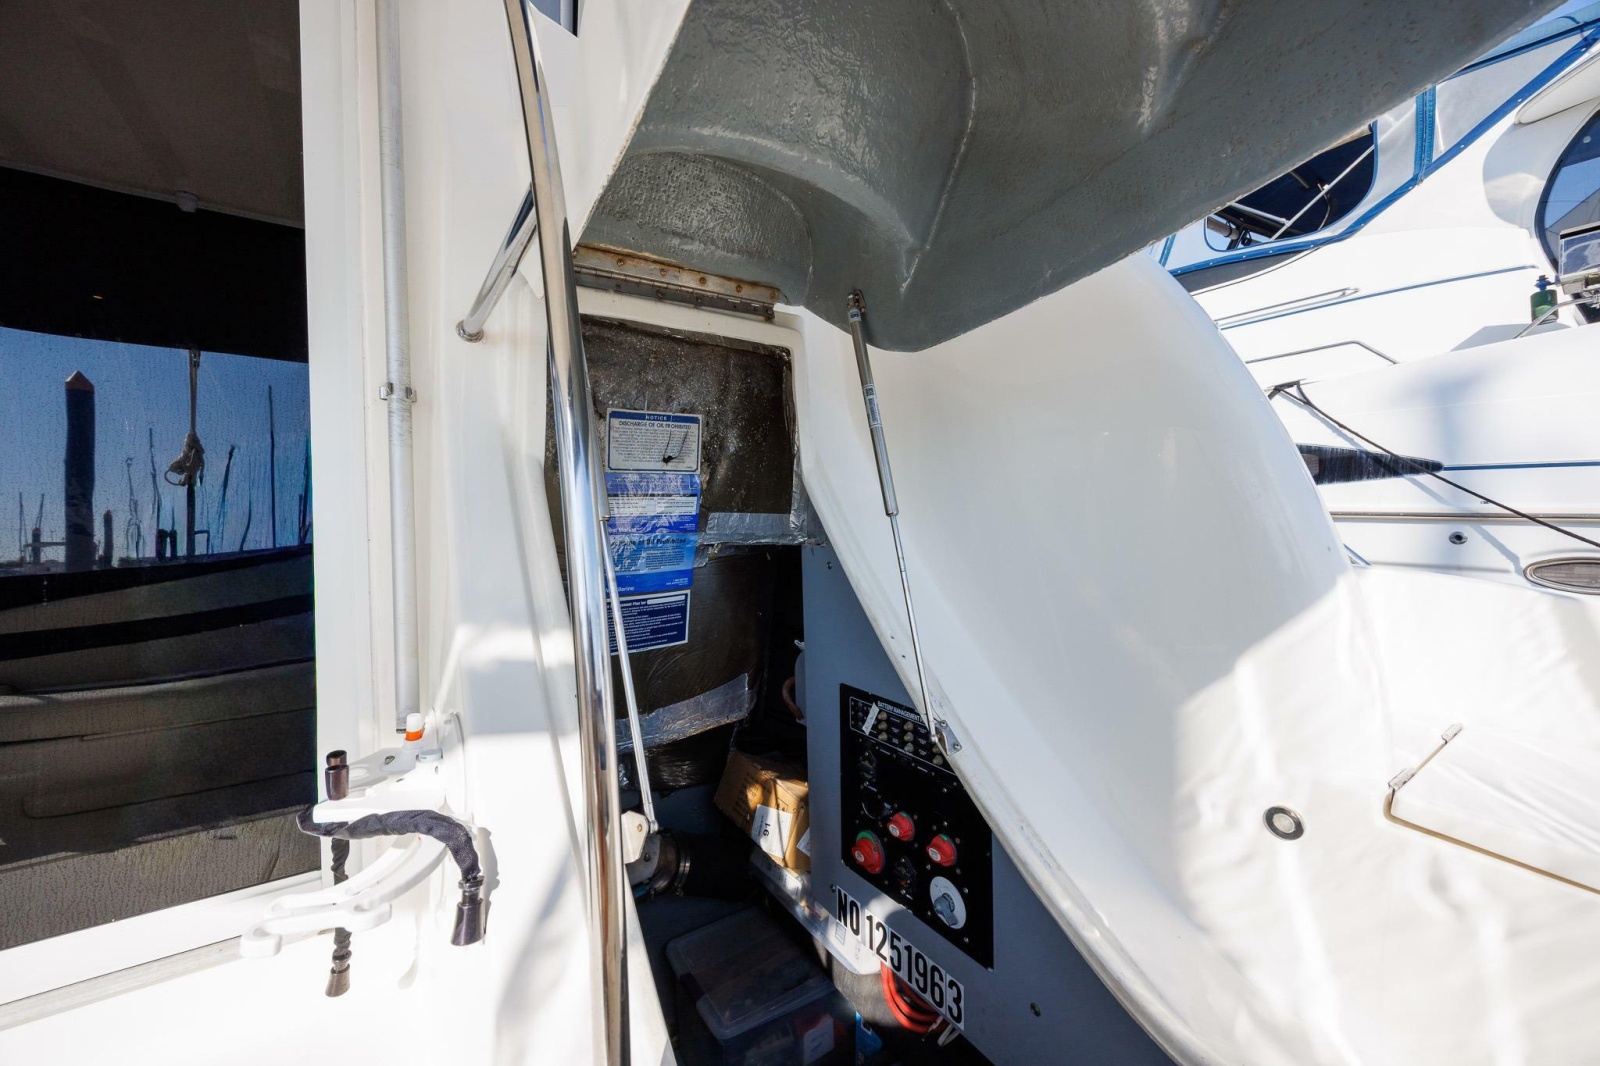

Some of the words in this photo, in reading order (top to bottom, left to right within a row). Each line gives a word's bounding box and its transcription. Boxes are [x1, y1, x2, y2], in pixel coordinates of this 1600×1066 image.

[893, 707, 920, 722] MANAGEMENT
[837, 888, 860, 936] NO
[866, 914, 962, 1024] 1251963
